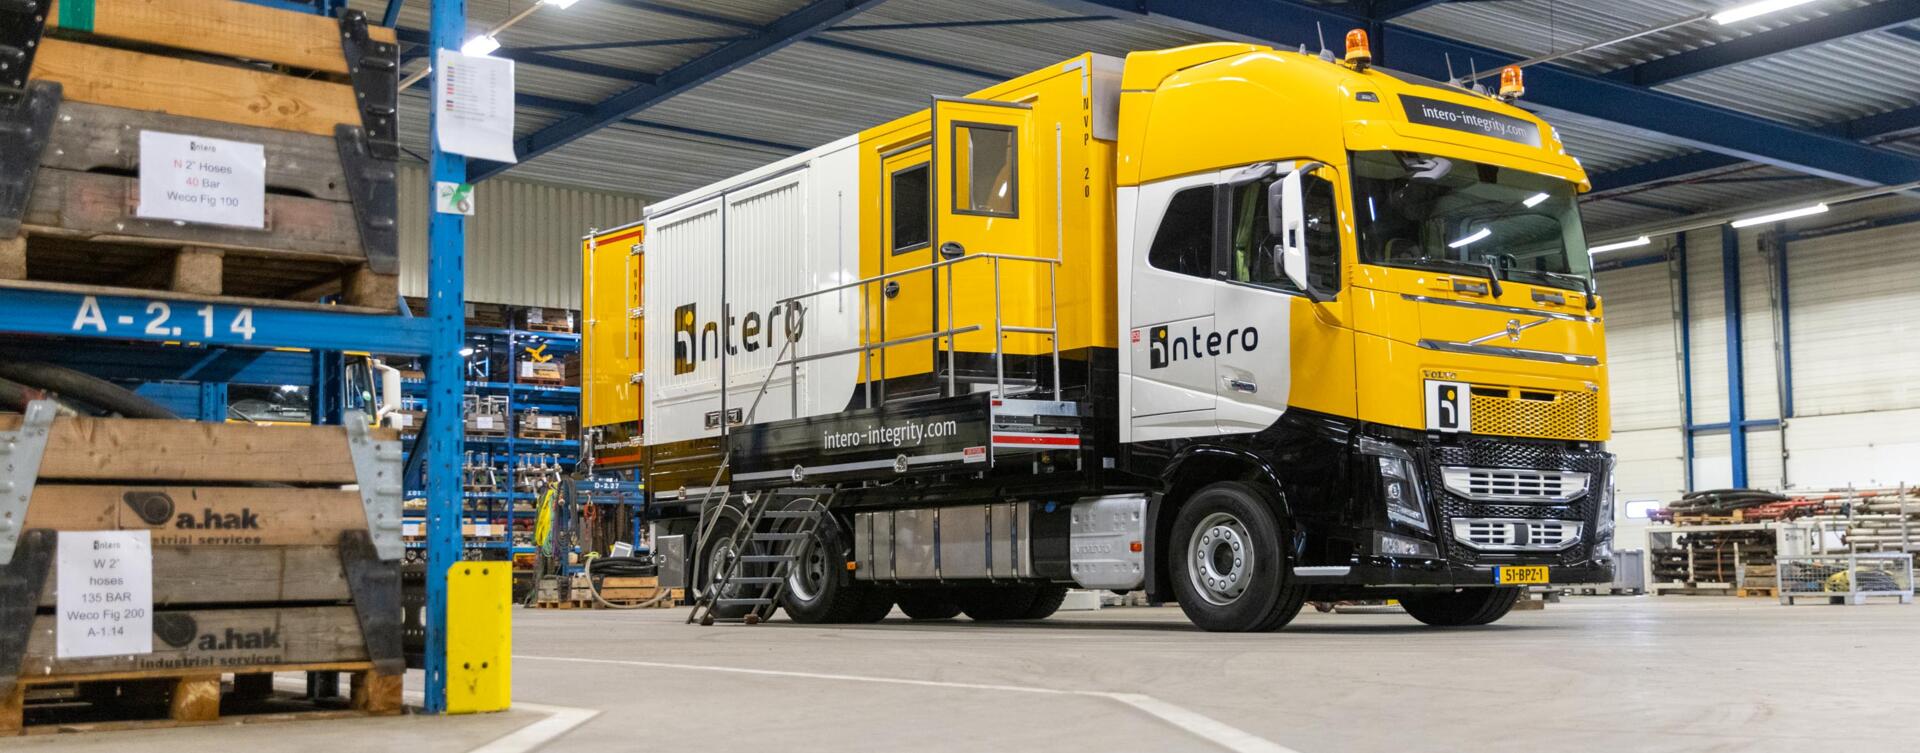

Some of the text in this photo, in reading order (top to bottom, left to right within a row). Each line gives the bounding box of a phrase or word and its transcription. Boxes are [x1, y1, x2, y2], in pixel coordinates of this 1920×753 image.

[1422, 104, 1529, 138] intero-integrity.com
[173, 160, 182, 168] N
[199, 161, 233, 175] Hoses
[186, 177, 221, 189] 40 Bar
[167, 191, 239, 208] Weco Fig 100
[72, 295, 256, 340] A-2.14
[674, 300, 804, 376] intero
[1150, 325, 1258, 369] intero
[824, 419, 957, 449] intero-integrity.com
[176, 508, 259, 529] a.hak
[151, 535, 262, 545] strial services
[94, 560, 106, 568] W
[90, 576, 124, 586] hoses
[1506, 569, 1543, 581] 51-BPZ-1
[82, 592, 131, 603] 135 BAR
[67, 608, 144, 621] Weco Fig 200
[198, 627, 281, 650] a.hak
[139, 653, 281, 669] industrial services
